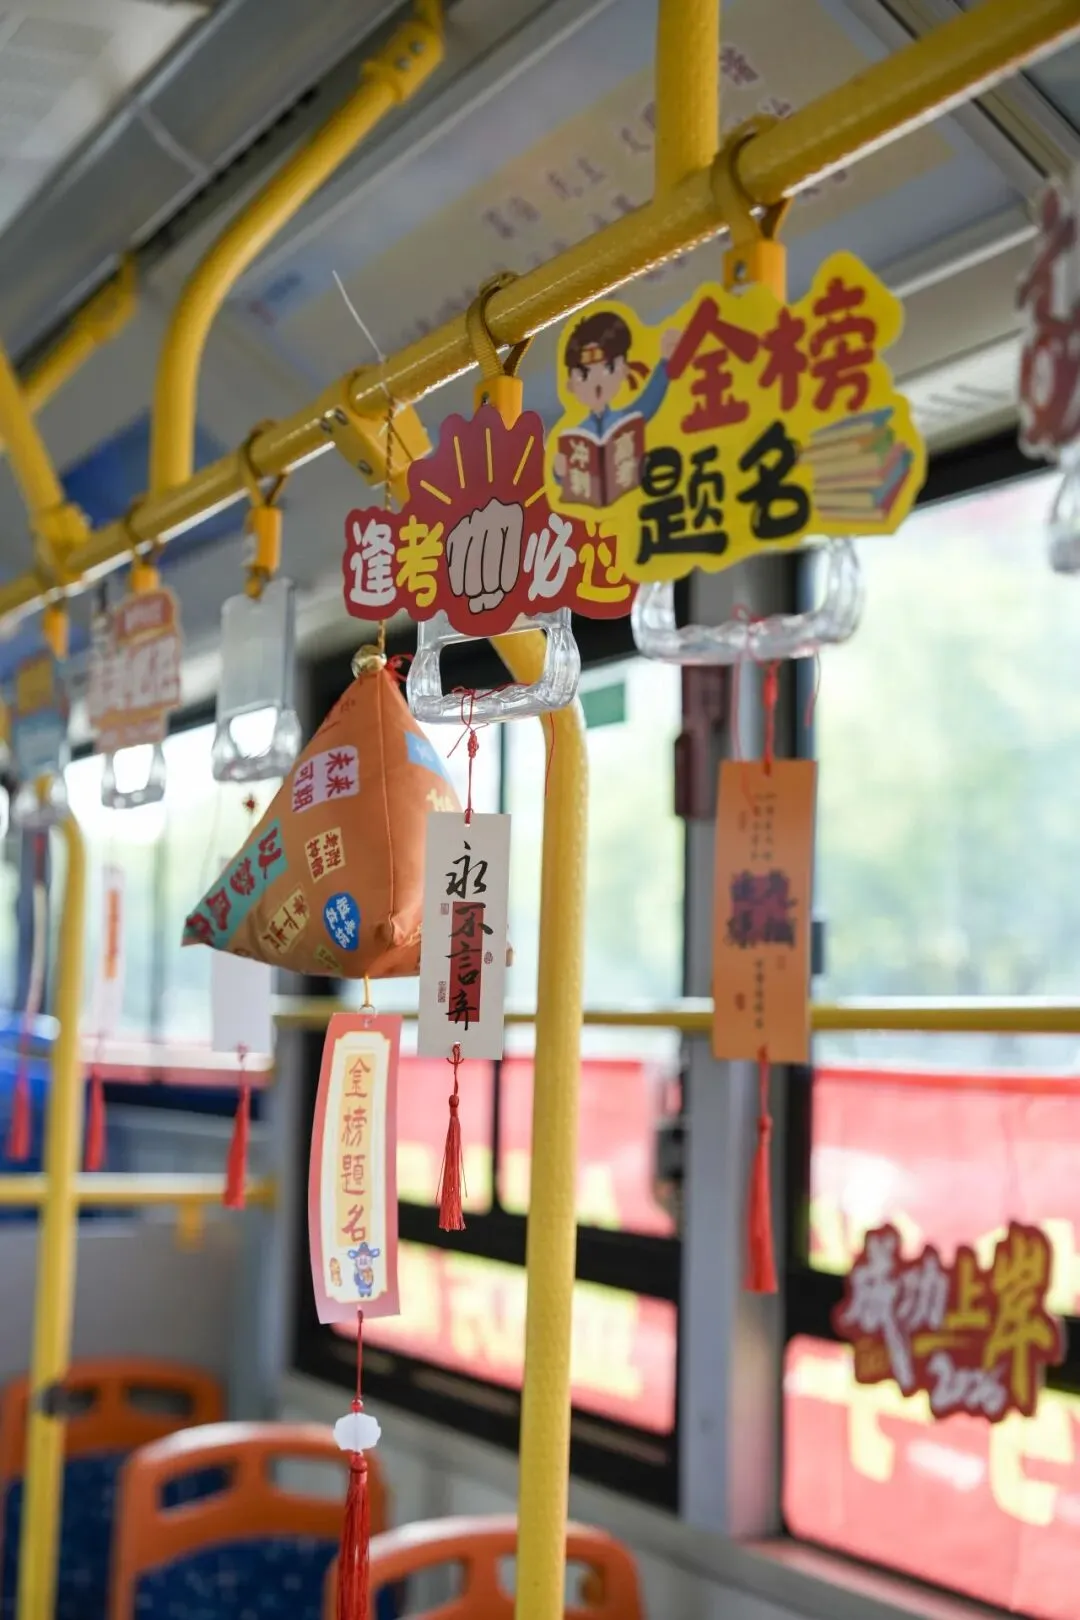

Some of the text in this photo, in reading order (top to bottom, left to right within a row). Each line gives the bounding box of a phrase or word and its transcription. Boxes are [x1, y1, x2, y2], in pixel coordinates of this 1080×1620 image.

[665, 277, 877, 434] 金榜
[635, 420, 811, 566] 题名
[293, 761, 314, 812] 可期
[325, 751, 355, 798] 未来
[445, 840, 493, 1031] 永不言弃
[340, 1057, 370, 1242] 金榜題名
[838, 1231, 1053, 1406] 成功上岸
[926, 1351, 1008, 1415] 2026
